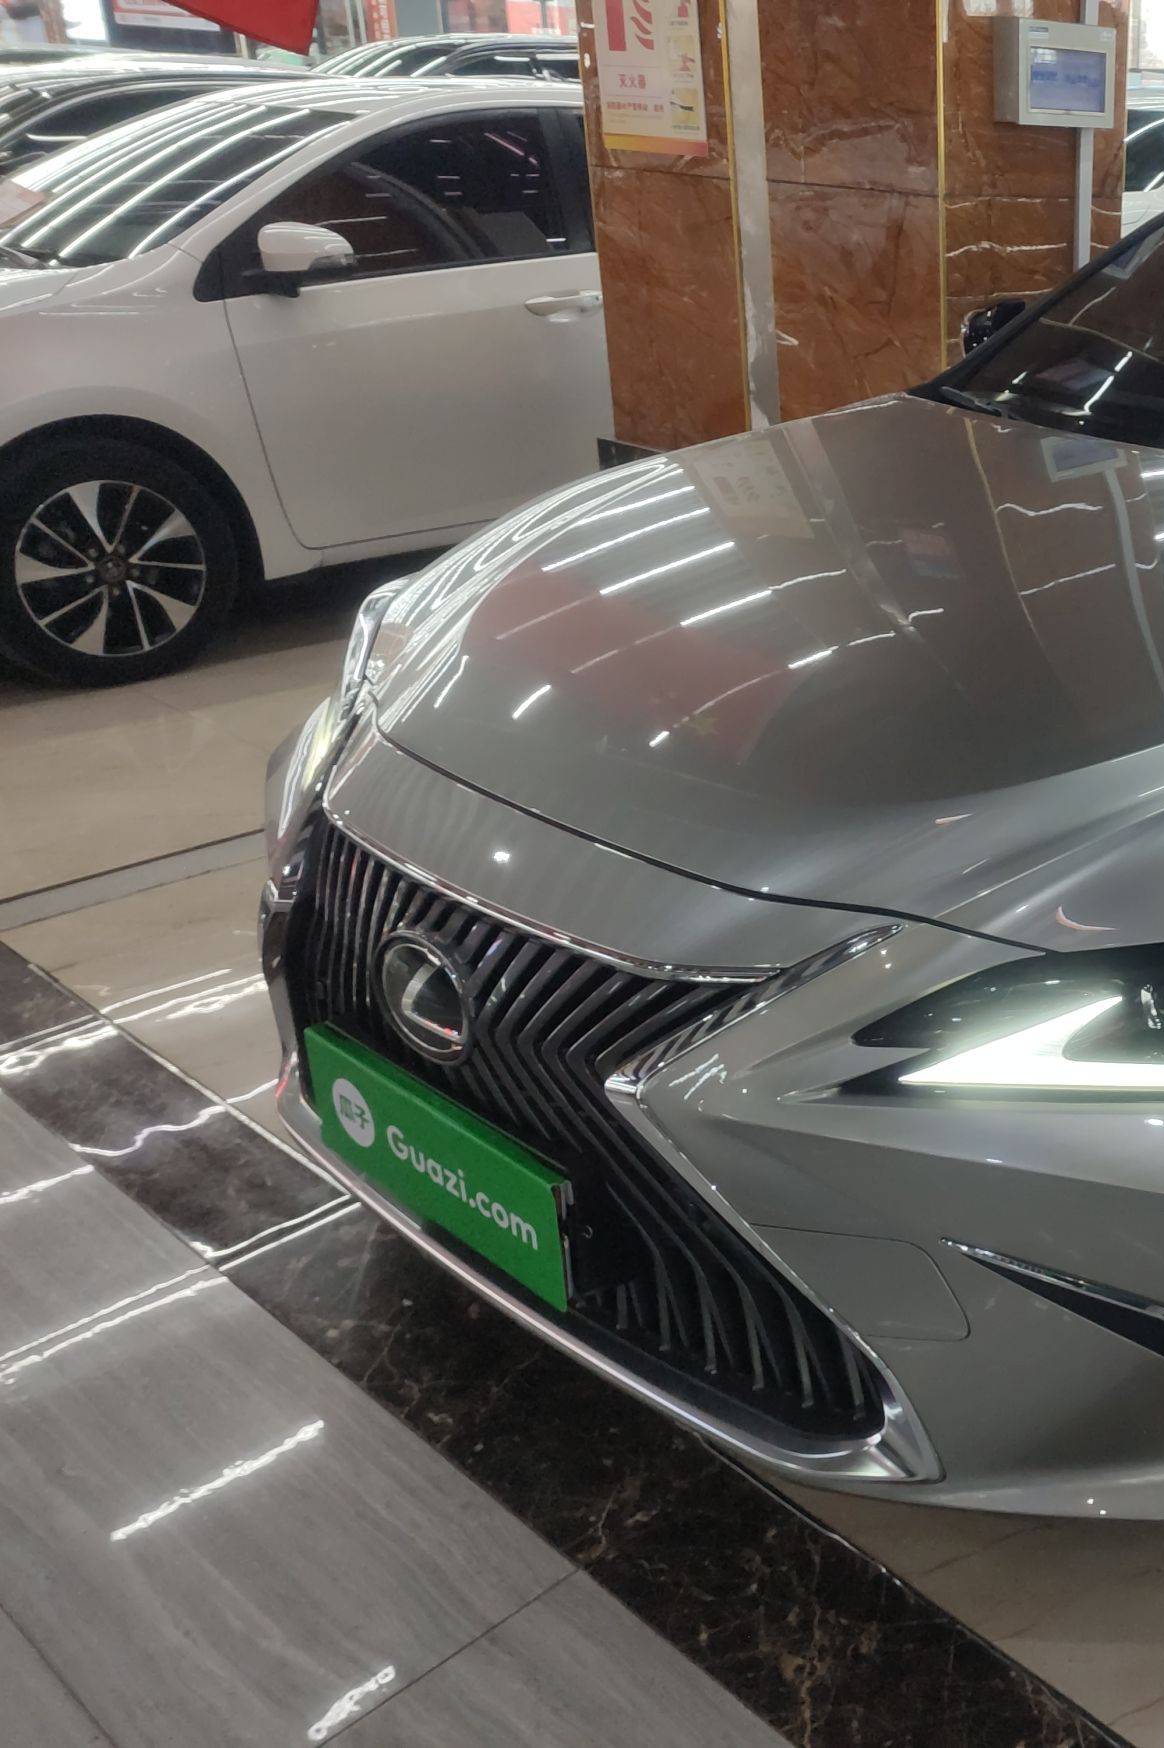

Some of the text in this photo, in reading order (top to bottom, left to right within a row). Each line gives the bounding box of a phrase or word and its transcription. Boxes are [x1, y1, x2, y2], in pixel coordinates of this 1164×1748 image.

[618, 73, 647, 90] 灭火器
[339, 1093, 371, 1130] 瓜子
[386, 1125, 539, 1250] Guazi.com
